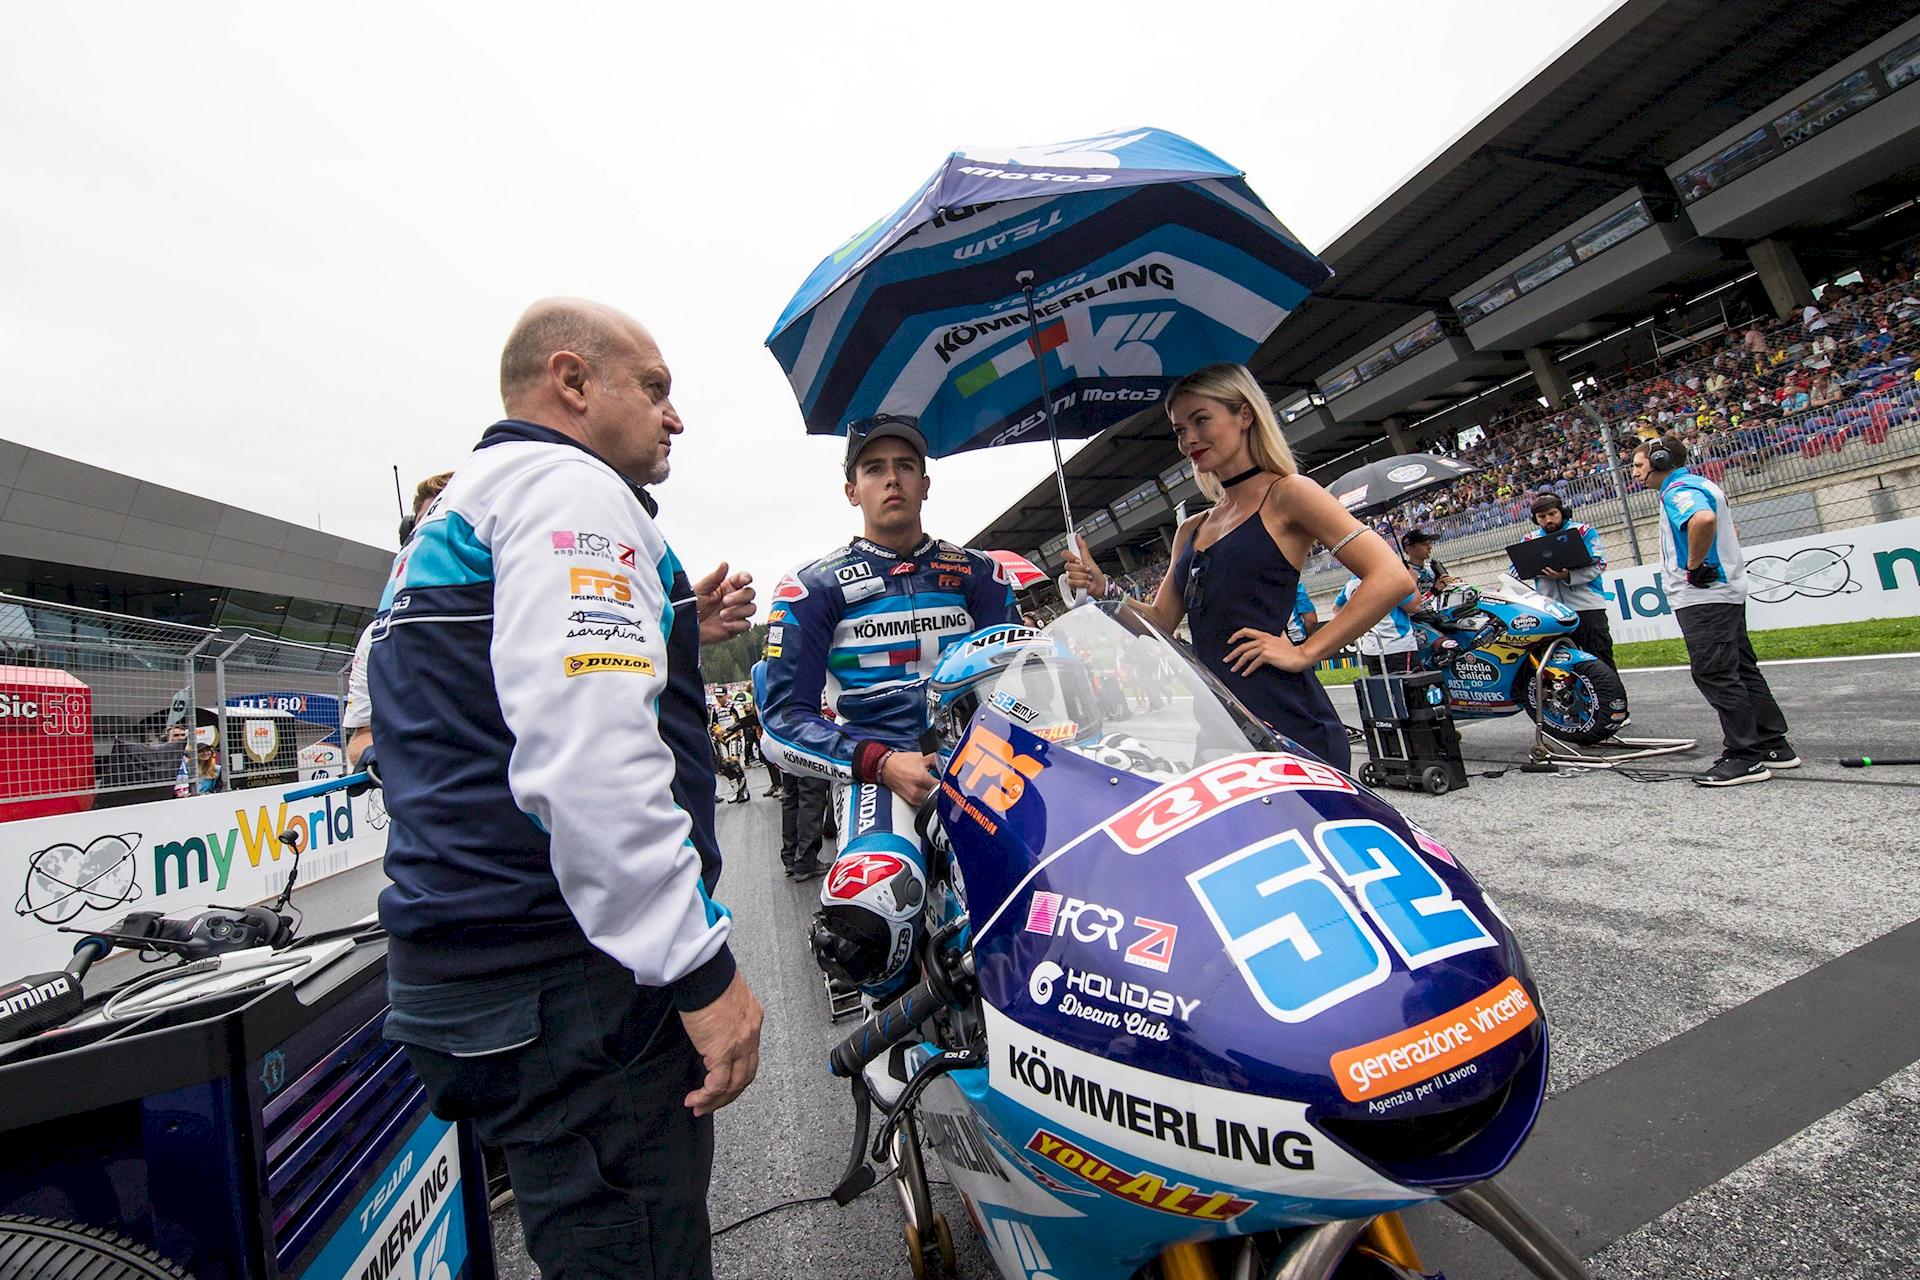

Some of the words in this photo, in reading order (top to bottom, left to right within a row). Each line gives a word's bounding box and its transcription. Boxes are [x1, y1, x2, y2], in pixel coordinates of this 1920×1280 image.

[934, 263, 1175, 364] KÖMMERLING
[988, 391, 1077, 448] GRESNI
[569, 567, 632, 602] FPS
[853, 612, 967, 640] KÖMMERLING
[966, 629, 1051, 656] NOLA
[1505, 635, 1532, 643] RACC
[587, 657, 650, 669] DUNLOP
[1455, 661, 1492, 673] Estrella
[1458, 670, 1492, 681] Galicia
[42, 692, 87, 736] 58
[1469, 690, 1505, 701] LOVERS
[948, 724, 1045, 813] FPS
[858, 782, 878, 835] ONDA
[965, 802, 999, 836] AUTOMATION
[153, 787, 355, 897] myWorld
[1057, 897, 1125, 951] FGR
[1185, 818, 1500, 1024] 52
[1058, 993, 1121, 1029] Dream
[1123, 1012, 1171, 1042] Club
[1349, 1022, 1473, 1092] generazione
[1469, 987, 1529, 1034] vincente
[1008, 1043, 1316, 1171] KÖMMERLING
[1368, 1090, 1414, 1115] Agenzia
[1417, 1083, 1434, 1101] per
[1434, 1075, 1444, 1091] il
[1445, 1063, 1478, 1086] Lavoro
[1038, 1133, 1235, 1220] YOU-ALL
